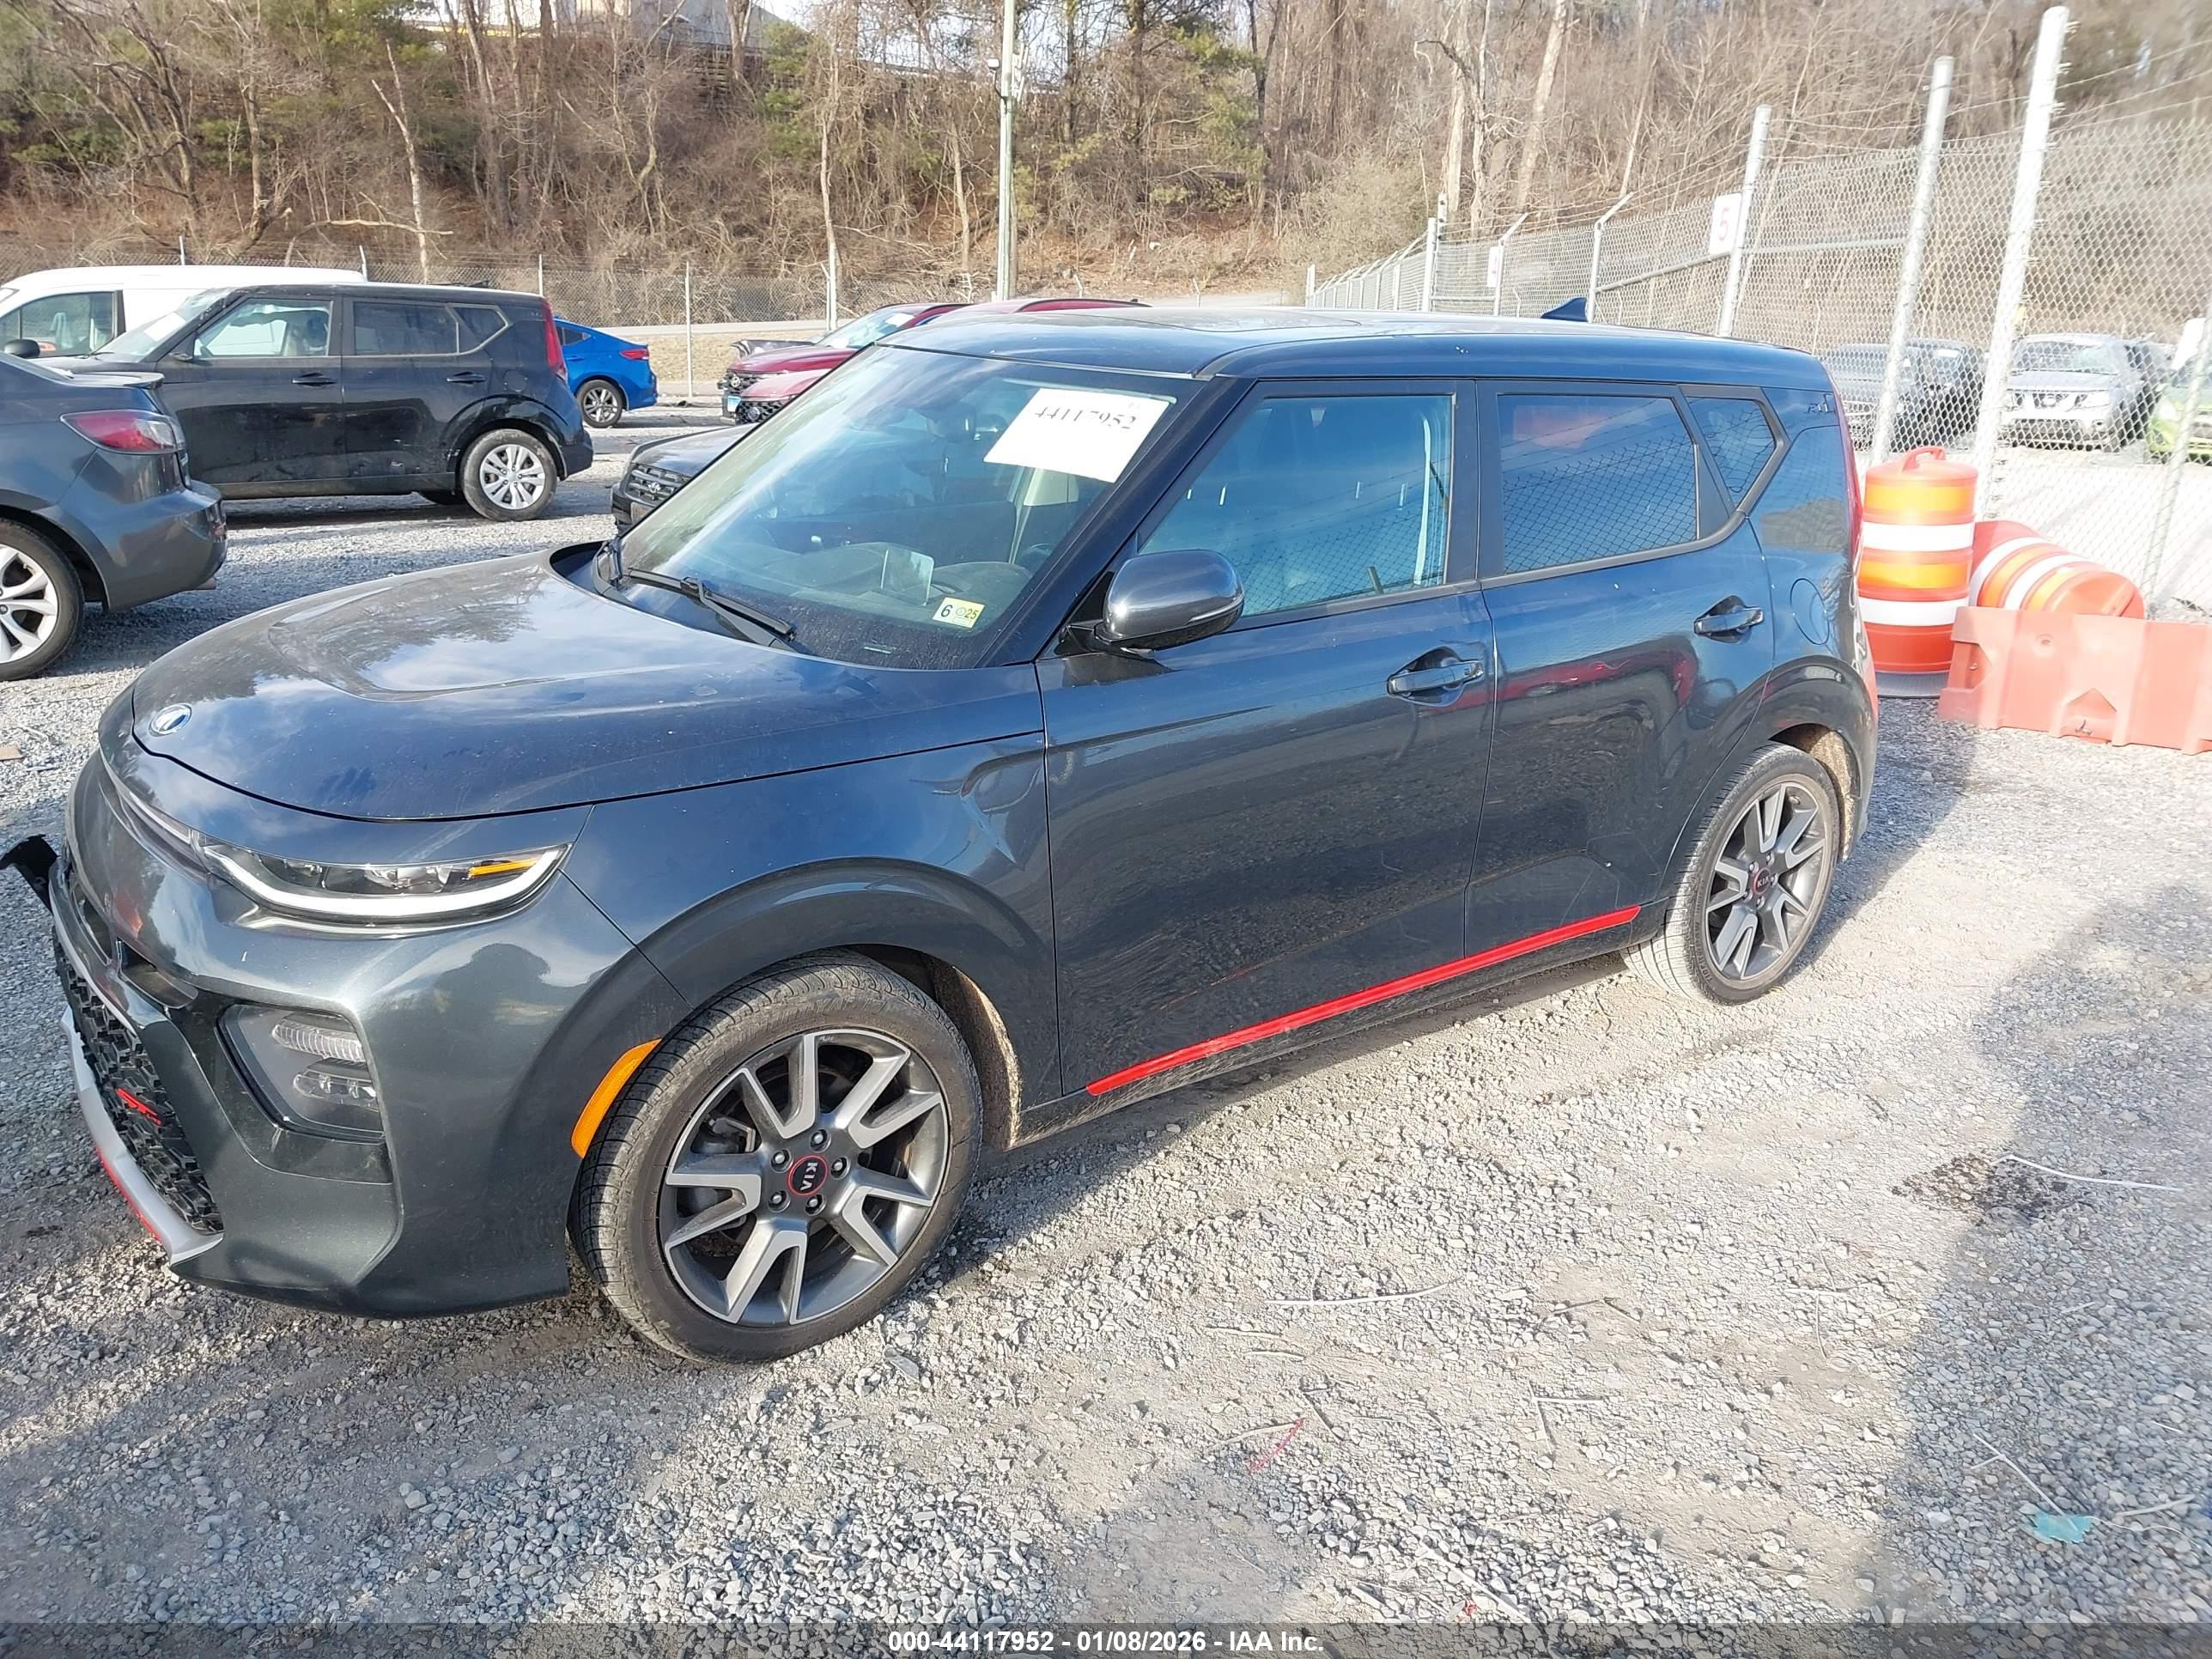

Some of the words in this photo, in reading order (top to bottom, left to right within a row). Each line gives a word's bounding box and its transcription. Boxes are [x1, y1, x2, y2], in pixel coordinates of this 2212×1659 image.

[1718, 206, 1730, 241] 5
[940, 605, 953, 617] 6
[963, 608, 979, 620] 25
[1757, 875, 1769, 888] KIA
[799, 1162, 818, 1191] KIA
